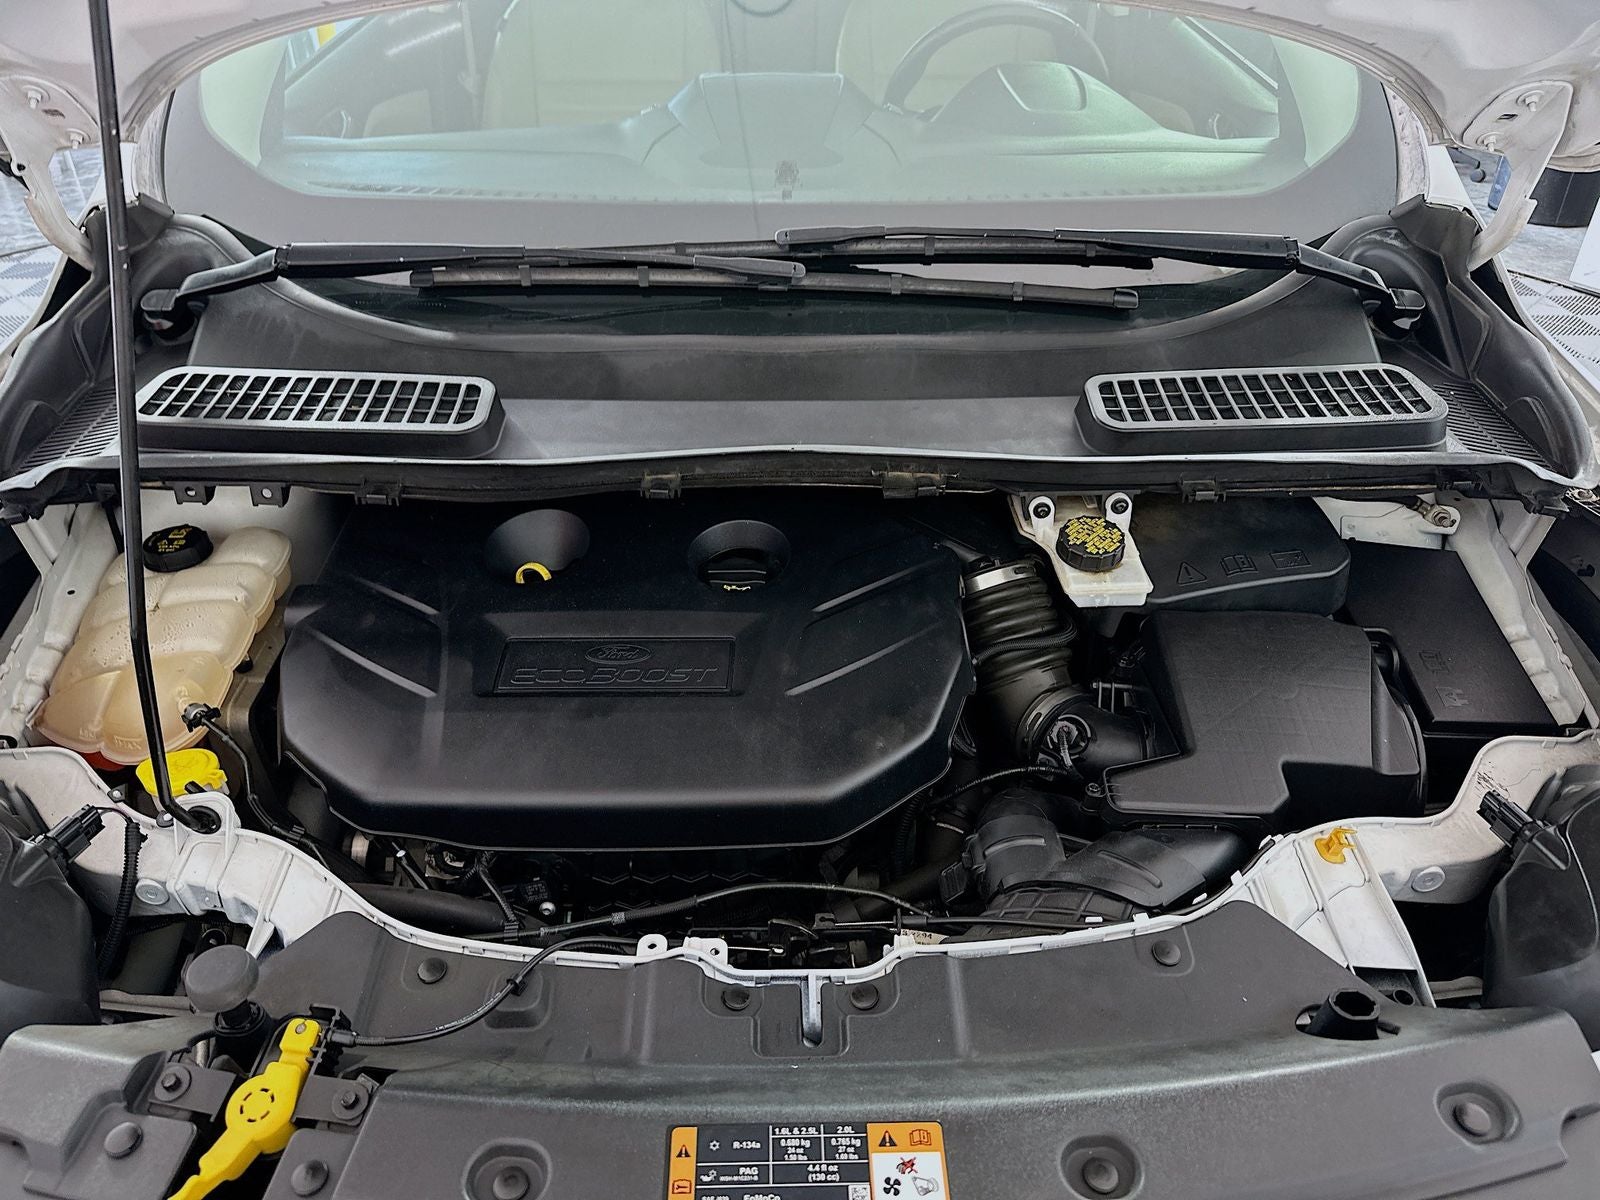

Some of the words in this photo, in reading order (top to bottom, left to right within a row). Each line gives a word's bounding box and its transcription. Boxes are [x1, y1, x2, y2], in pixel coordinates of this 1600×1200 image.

[599, 645, 639, 660] Ford
[510, 667, 719, 685] ECOBOOST
[836, 1125, 855, 1134] 2.0L
[732, 1140, 761, 1149] R-134a
[801, 1138, 811, 1148] kg
[851, 1137, 861, 1147] kg
[739, 1166, 759, 1175] PAG
[807, 1164, 820, 1172] 4.4
